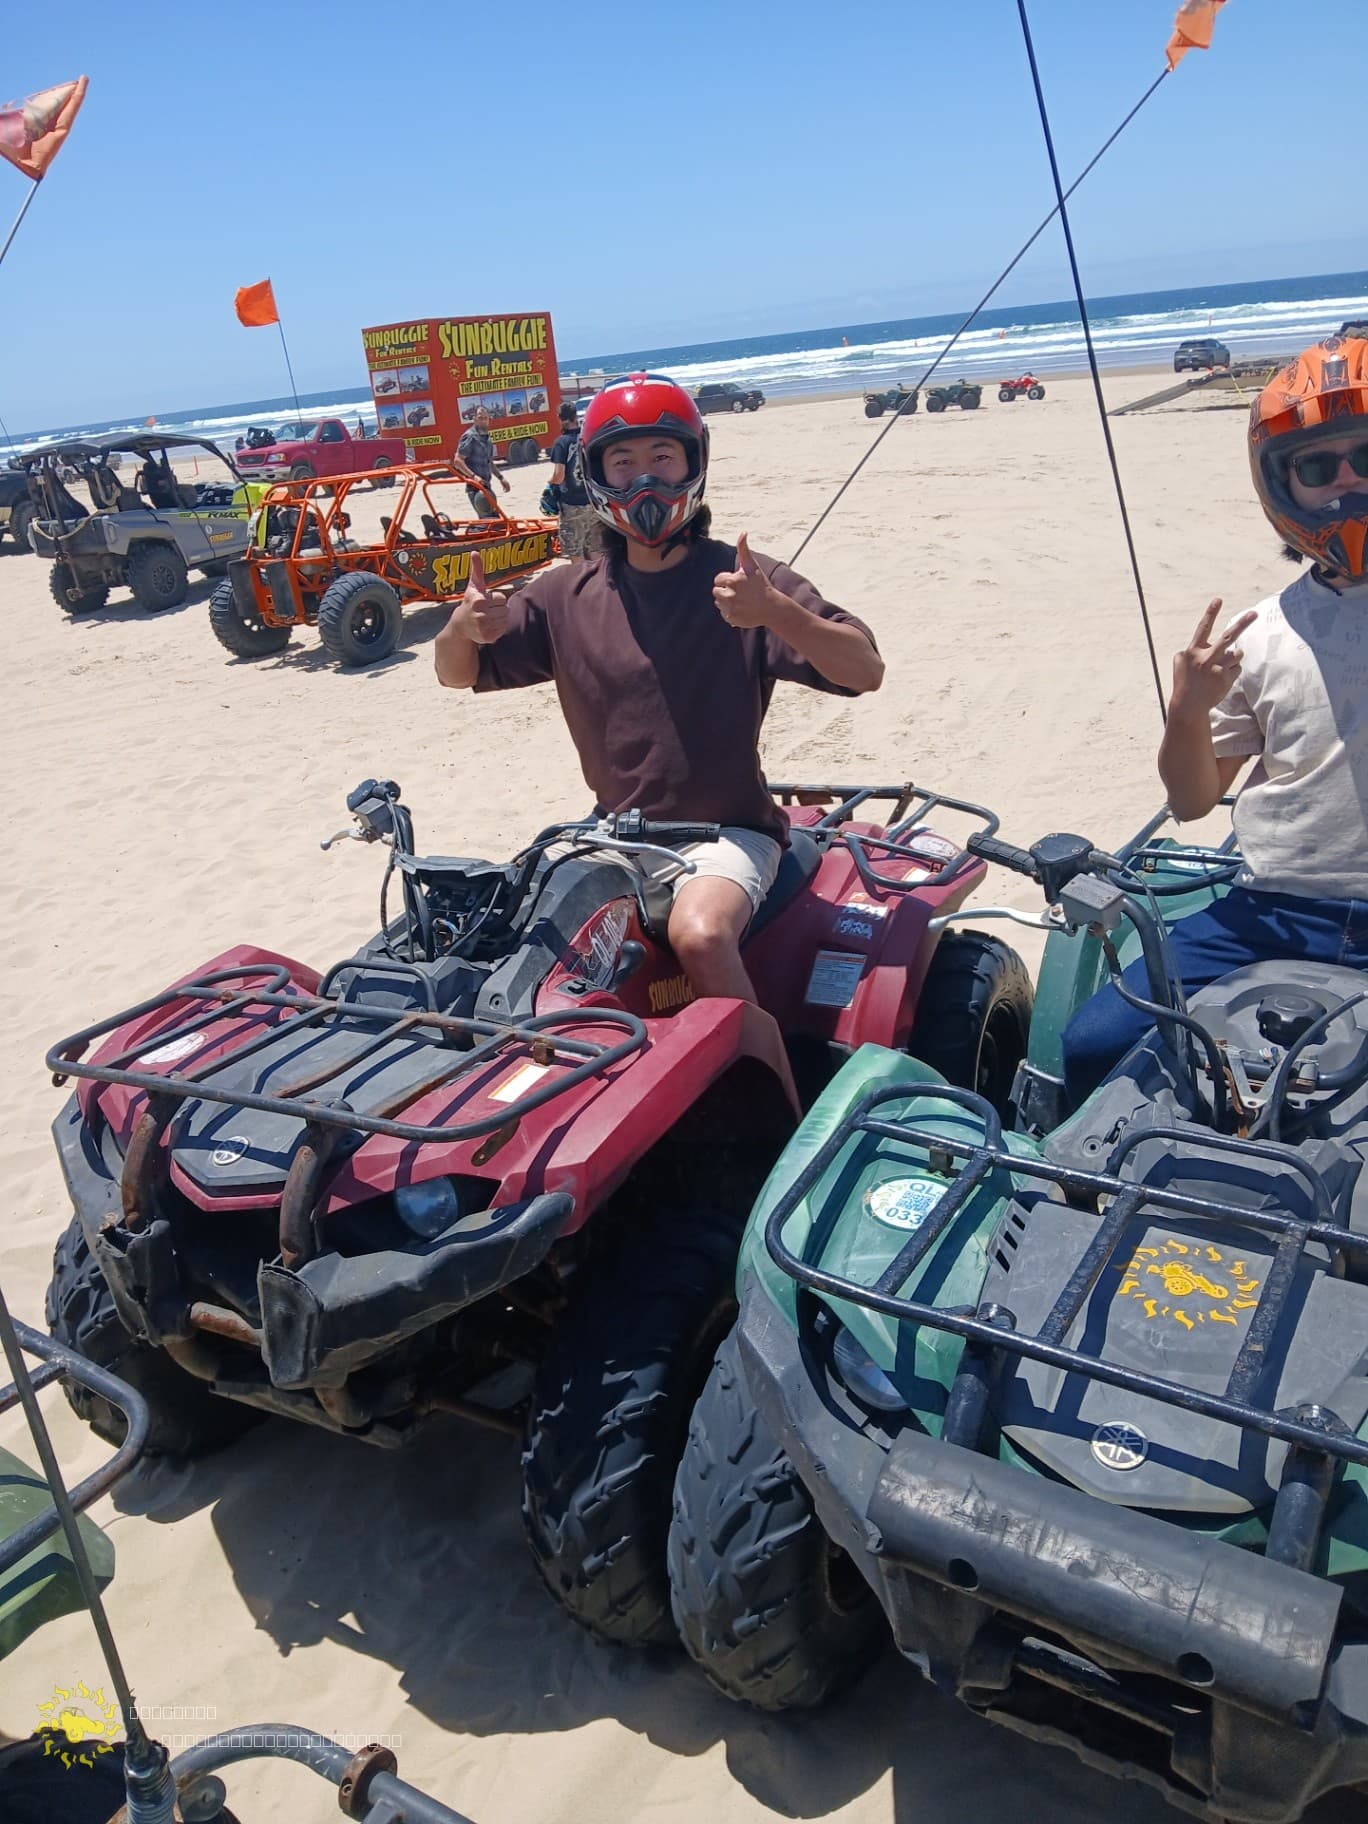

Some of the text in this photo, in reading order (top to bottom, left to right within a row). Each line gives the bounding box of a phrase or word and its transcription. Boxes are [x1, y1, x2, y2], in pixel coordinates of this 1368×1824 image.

[363, 325, 429, 348] SUNBUGGIE
[438, 317, 547, 358] SUNBUGGIE
[460, 382, 473, 394] THE
[432, 533, 548, 581] SUBUGGIE
